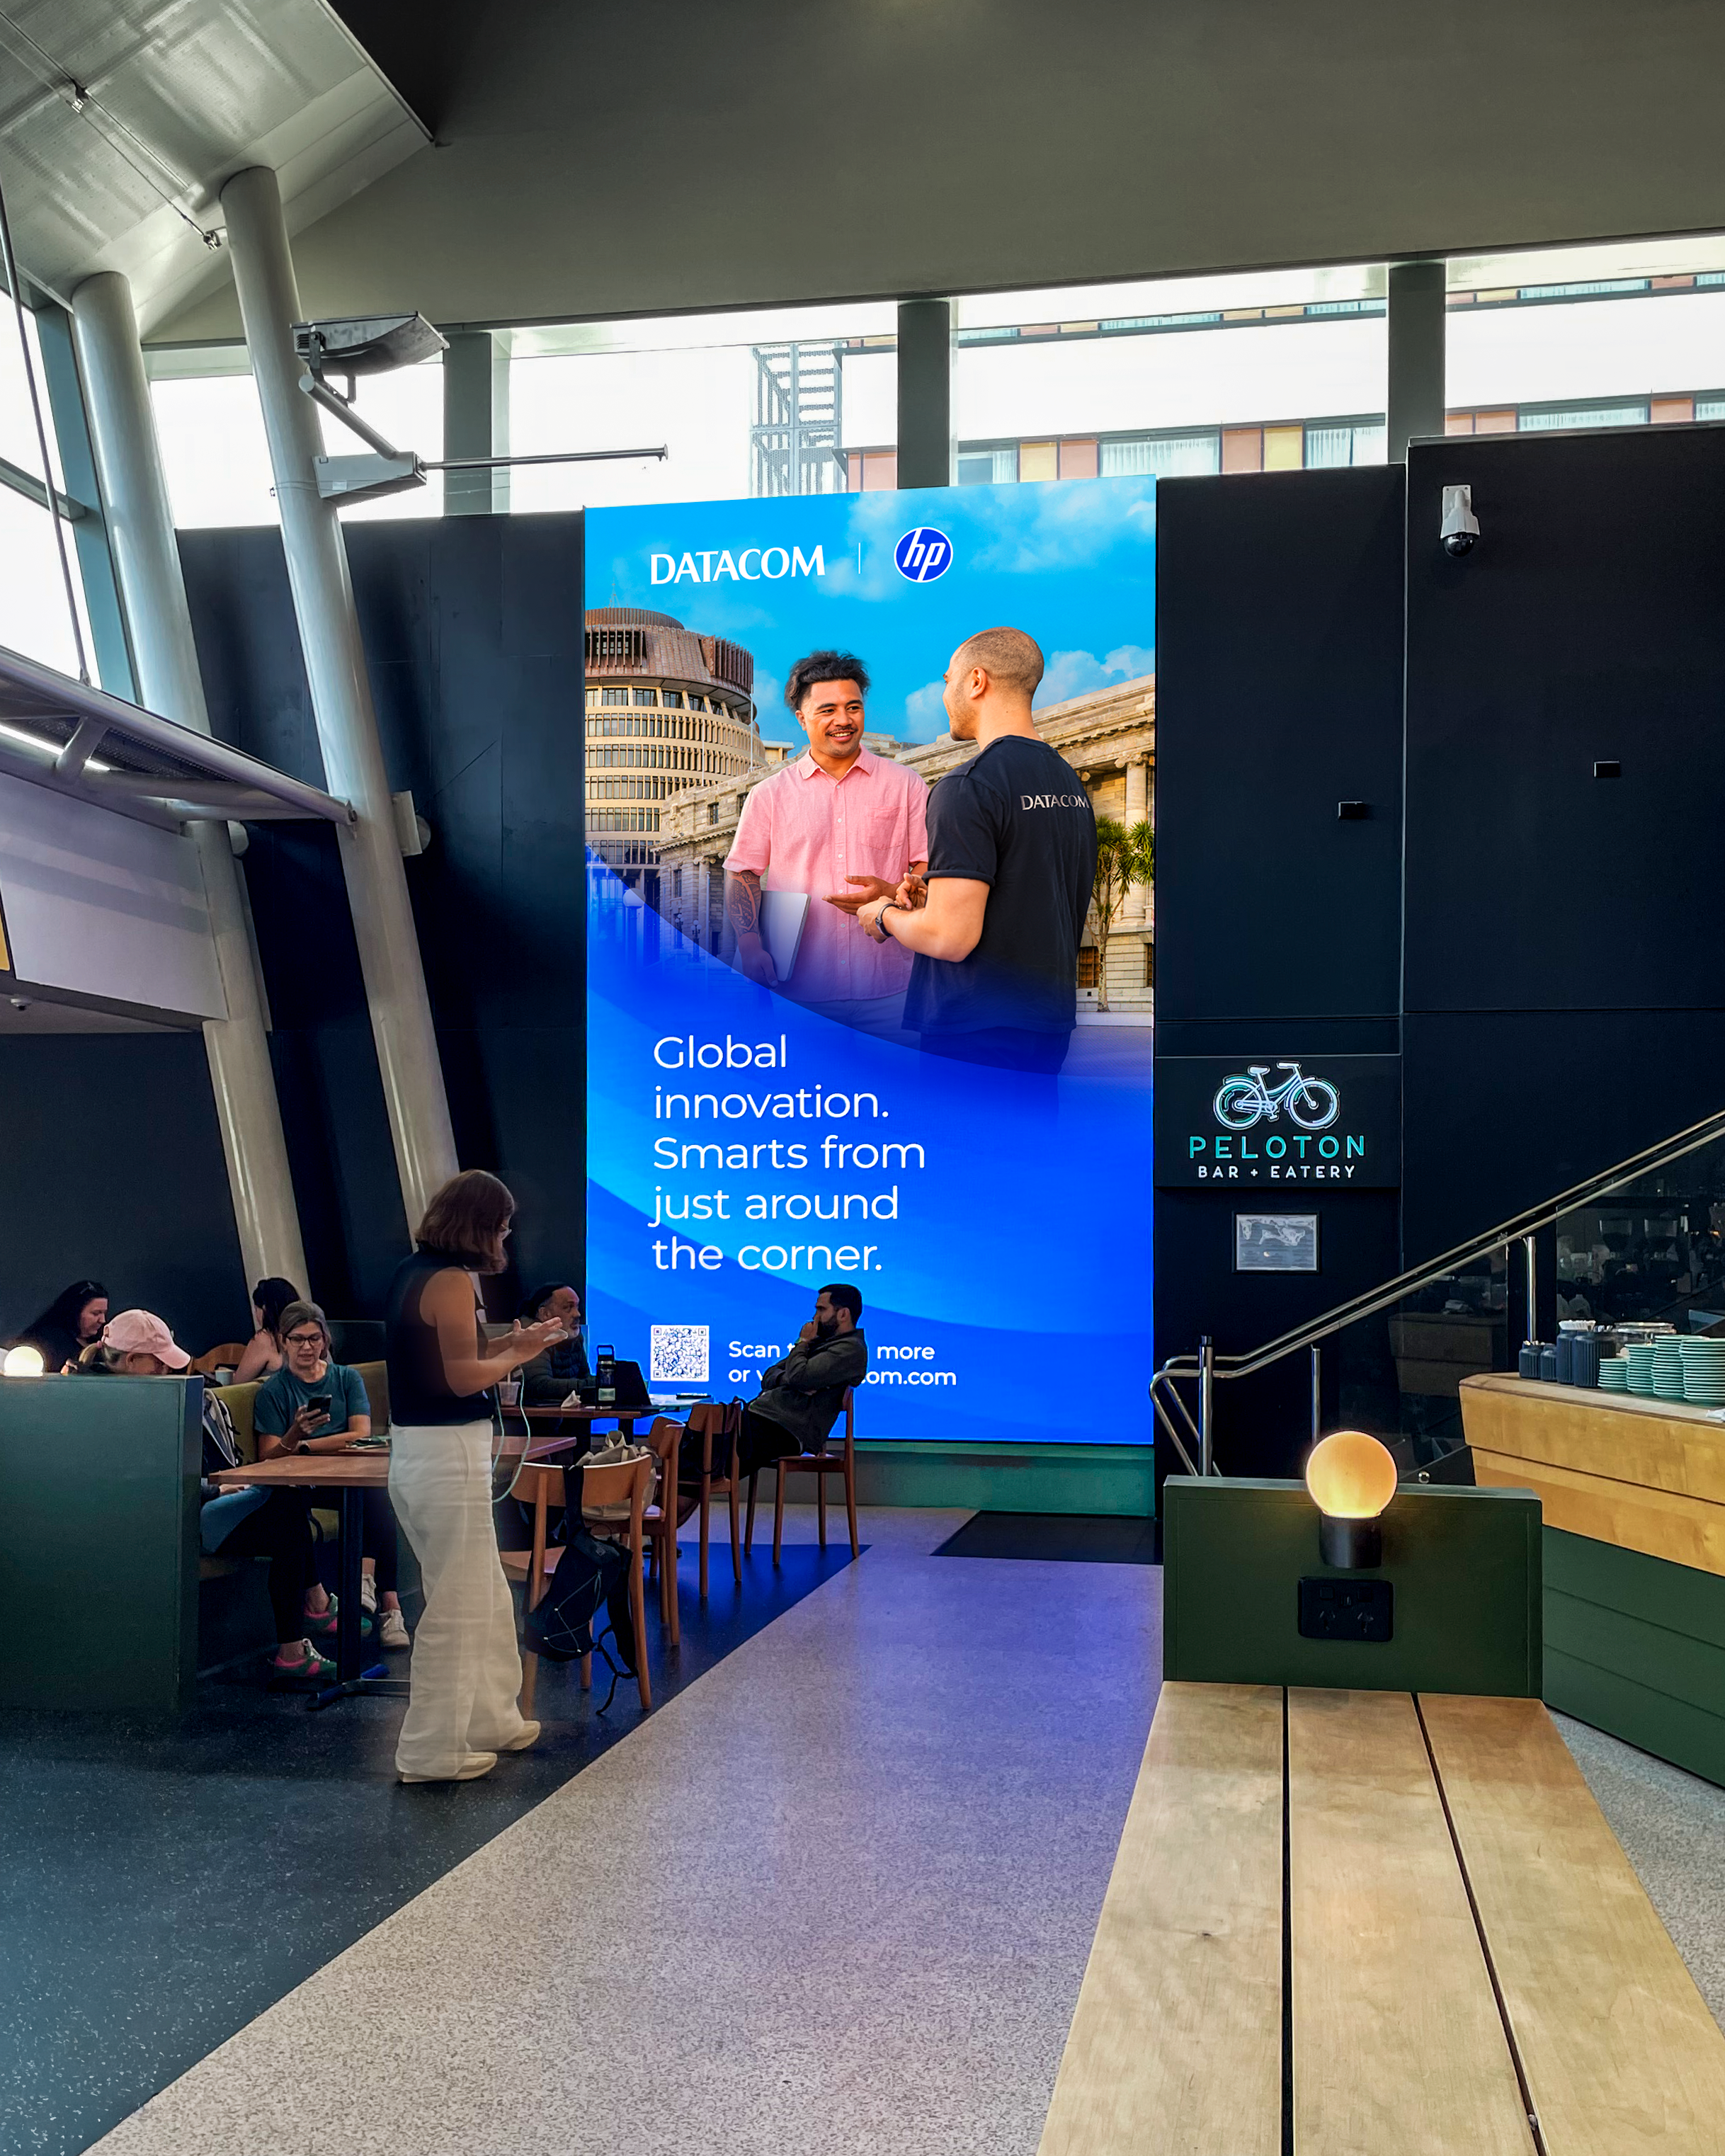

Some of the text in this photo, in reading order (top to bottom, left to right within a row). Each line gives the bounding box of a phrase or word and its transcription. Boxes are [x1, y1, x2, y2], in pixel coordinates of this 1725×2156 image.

[650, 544, 826, 585] DATACOM
[901, 528, 947, 582] hp
[1020, 794, 1089, 811] DATACOM
[654, 1034, 786, 1068] Global
[655, 1084, 889, 1119] innovation.
[654, 1134, 925, 1169] Smarts from
[1189, 1135, 1365, 1158] PELOTON
[1198, 1165, 1239, 1178] BAR
[1270, 1165, 1355, 1178] EATERY
[647, 1185, 899, 1228] just around
[651, 1236, 882, 1271] the corner.
[729, 1340, 780, 1358] Scan
[877, 1346, 935, 1360] more
[728, 1369, 751, 1383] or
[861, 1371, 957, 1386] om.com
